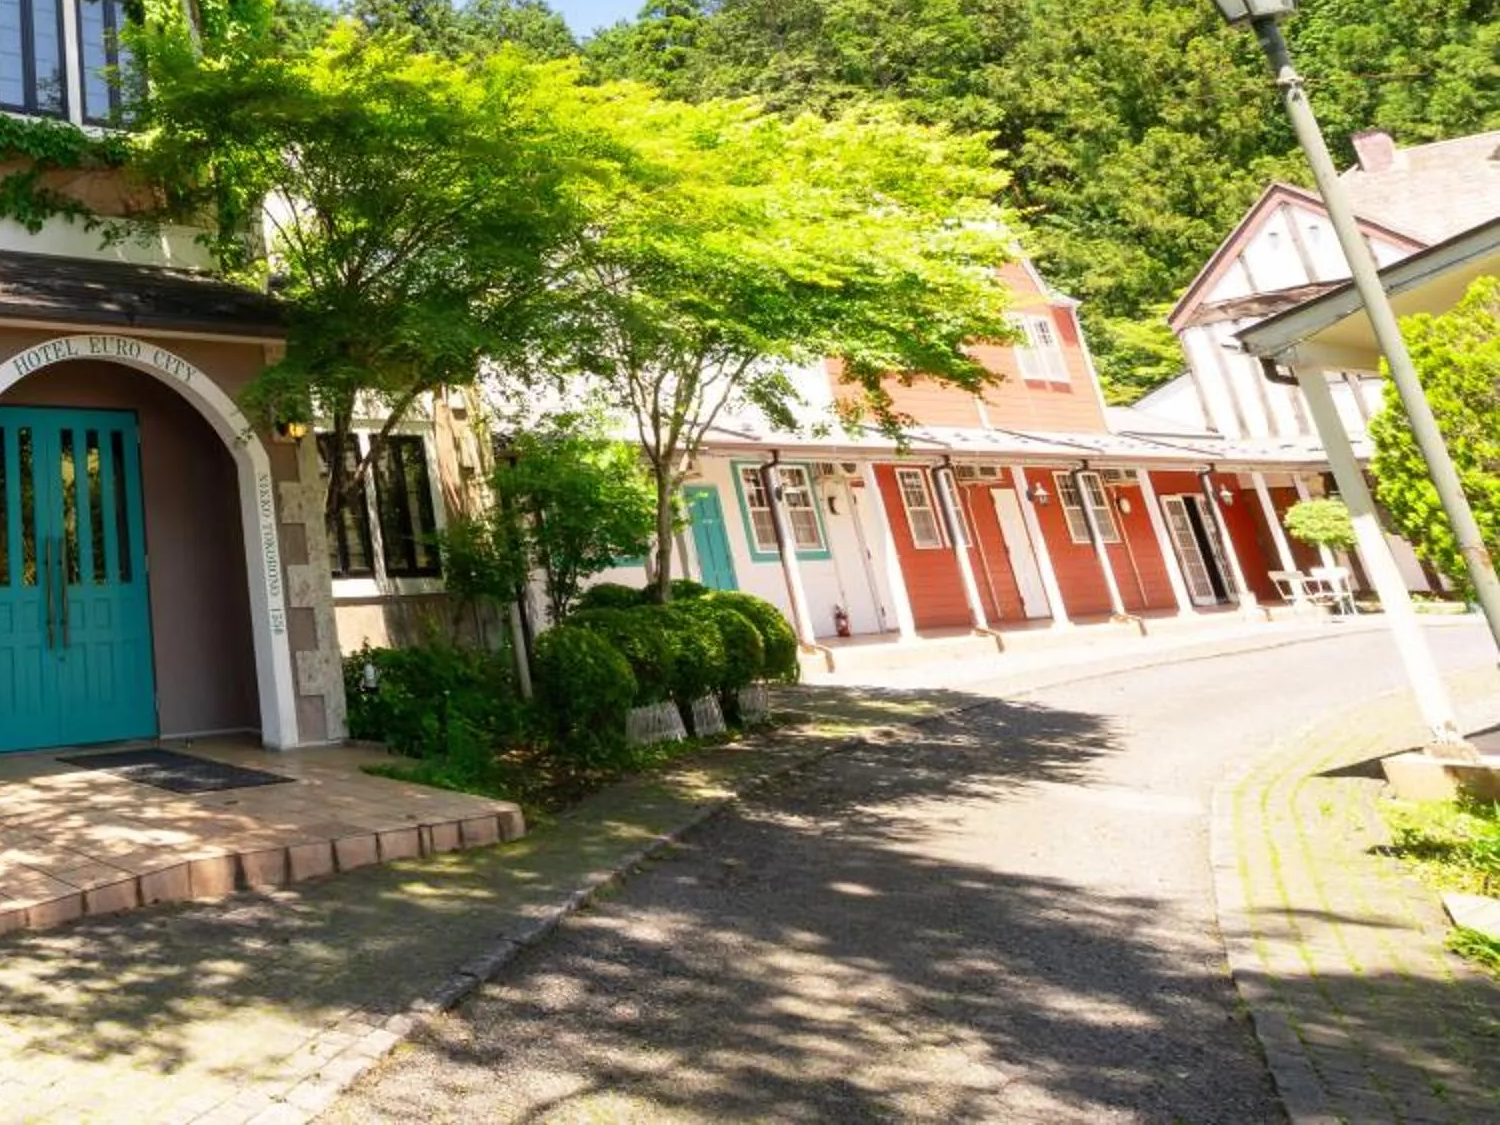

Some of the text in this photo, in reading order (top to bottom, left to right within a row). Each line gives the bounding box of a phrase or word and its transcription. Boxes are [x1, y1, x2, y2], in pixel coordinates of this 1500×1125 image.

[13, 336, 197, 382] HOTEL EURO CITY
